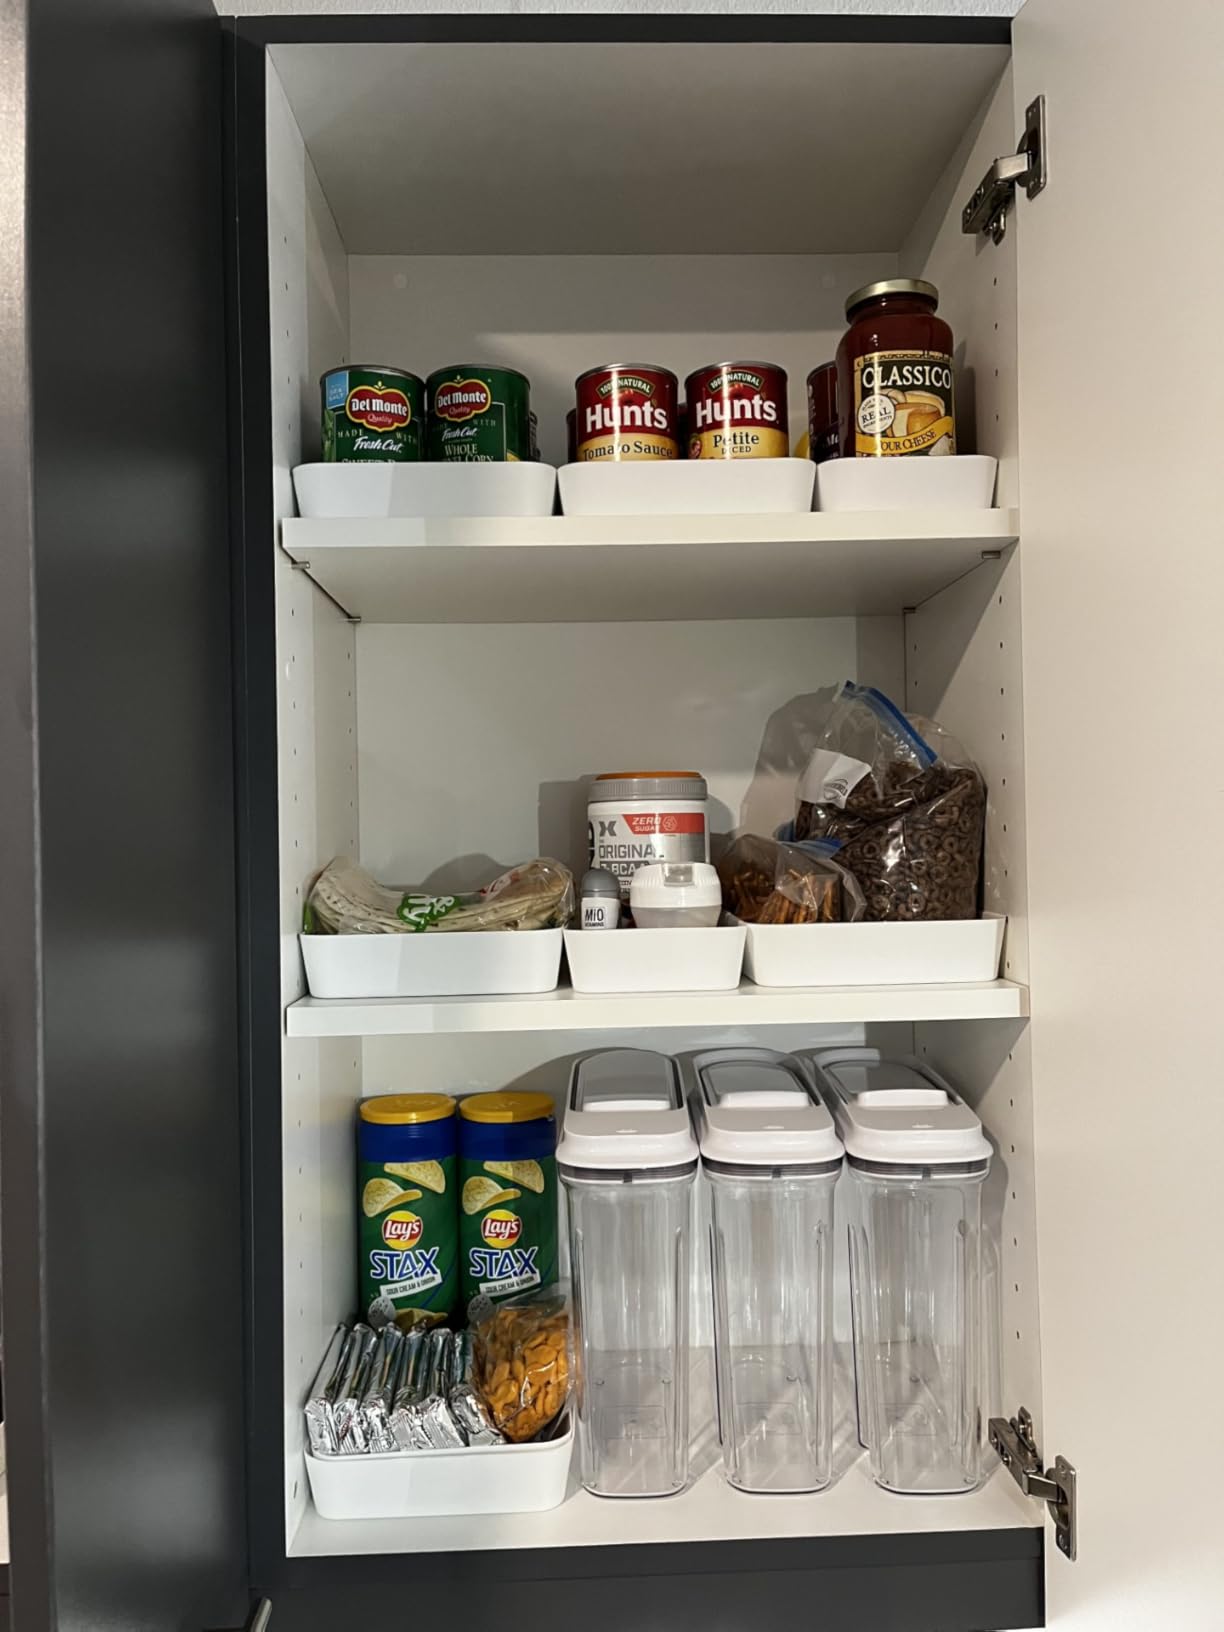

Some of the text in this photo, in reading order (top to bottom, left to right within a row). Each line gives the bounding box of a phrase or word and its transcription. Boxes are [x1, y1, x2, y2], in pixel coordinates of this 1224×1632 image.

[618, 377, 651, 393] NATURAL
[726, 371, 760, 387] NATURAL
[863, 365, 952, 389] CLASSICO
[351, 398, 408, 416] Del Monte
[438, 391, 487, 408] Del Monte
[367, 413, 393, 424] Quality
[449, 406, 471, 415] Quality
[337, 428, 365, 438] MADE
[713, 431, 760, 449] Petite
[880, 429, 937, 451] OUR CHEESE
[353, 436, 383, 452] Fresh
[445, 443, 478, 456] WHOLE
[583, 440, 673, 461] Tomao Sauce
[721, 445, 752, 455] DCED
[632, 816, 662, 826] ZERO
[385, 1219, 420, 1241] Lay's
[484, 1218, 519, 1240] Lay's
[369, 1247, 440, 1280] STAX
[469, 1246, 539, 1279] STAX
[399, 1284, 416, 1293] CREAM
[421, 1276, 436, 1286] ONION
[498, 1282, 515, 1292] CREAM
